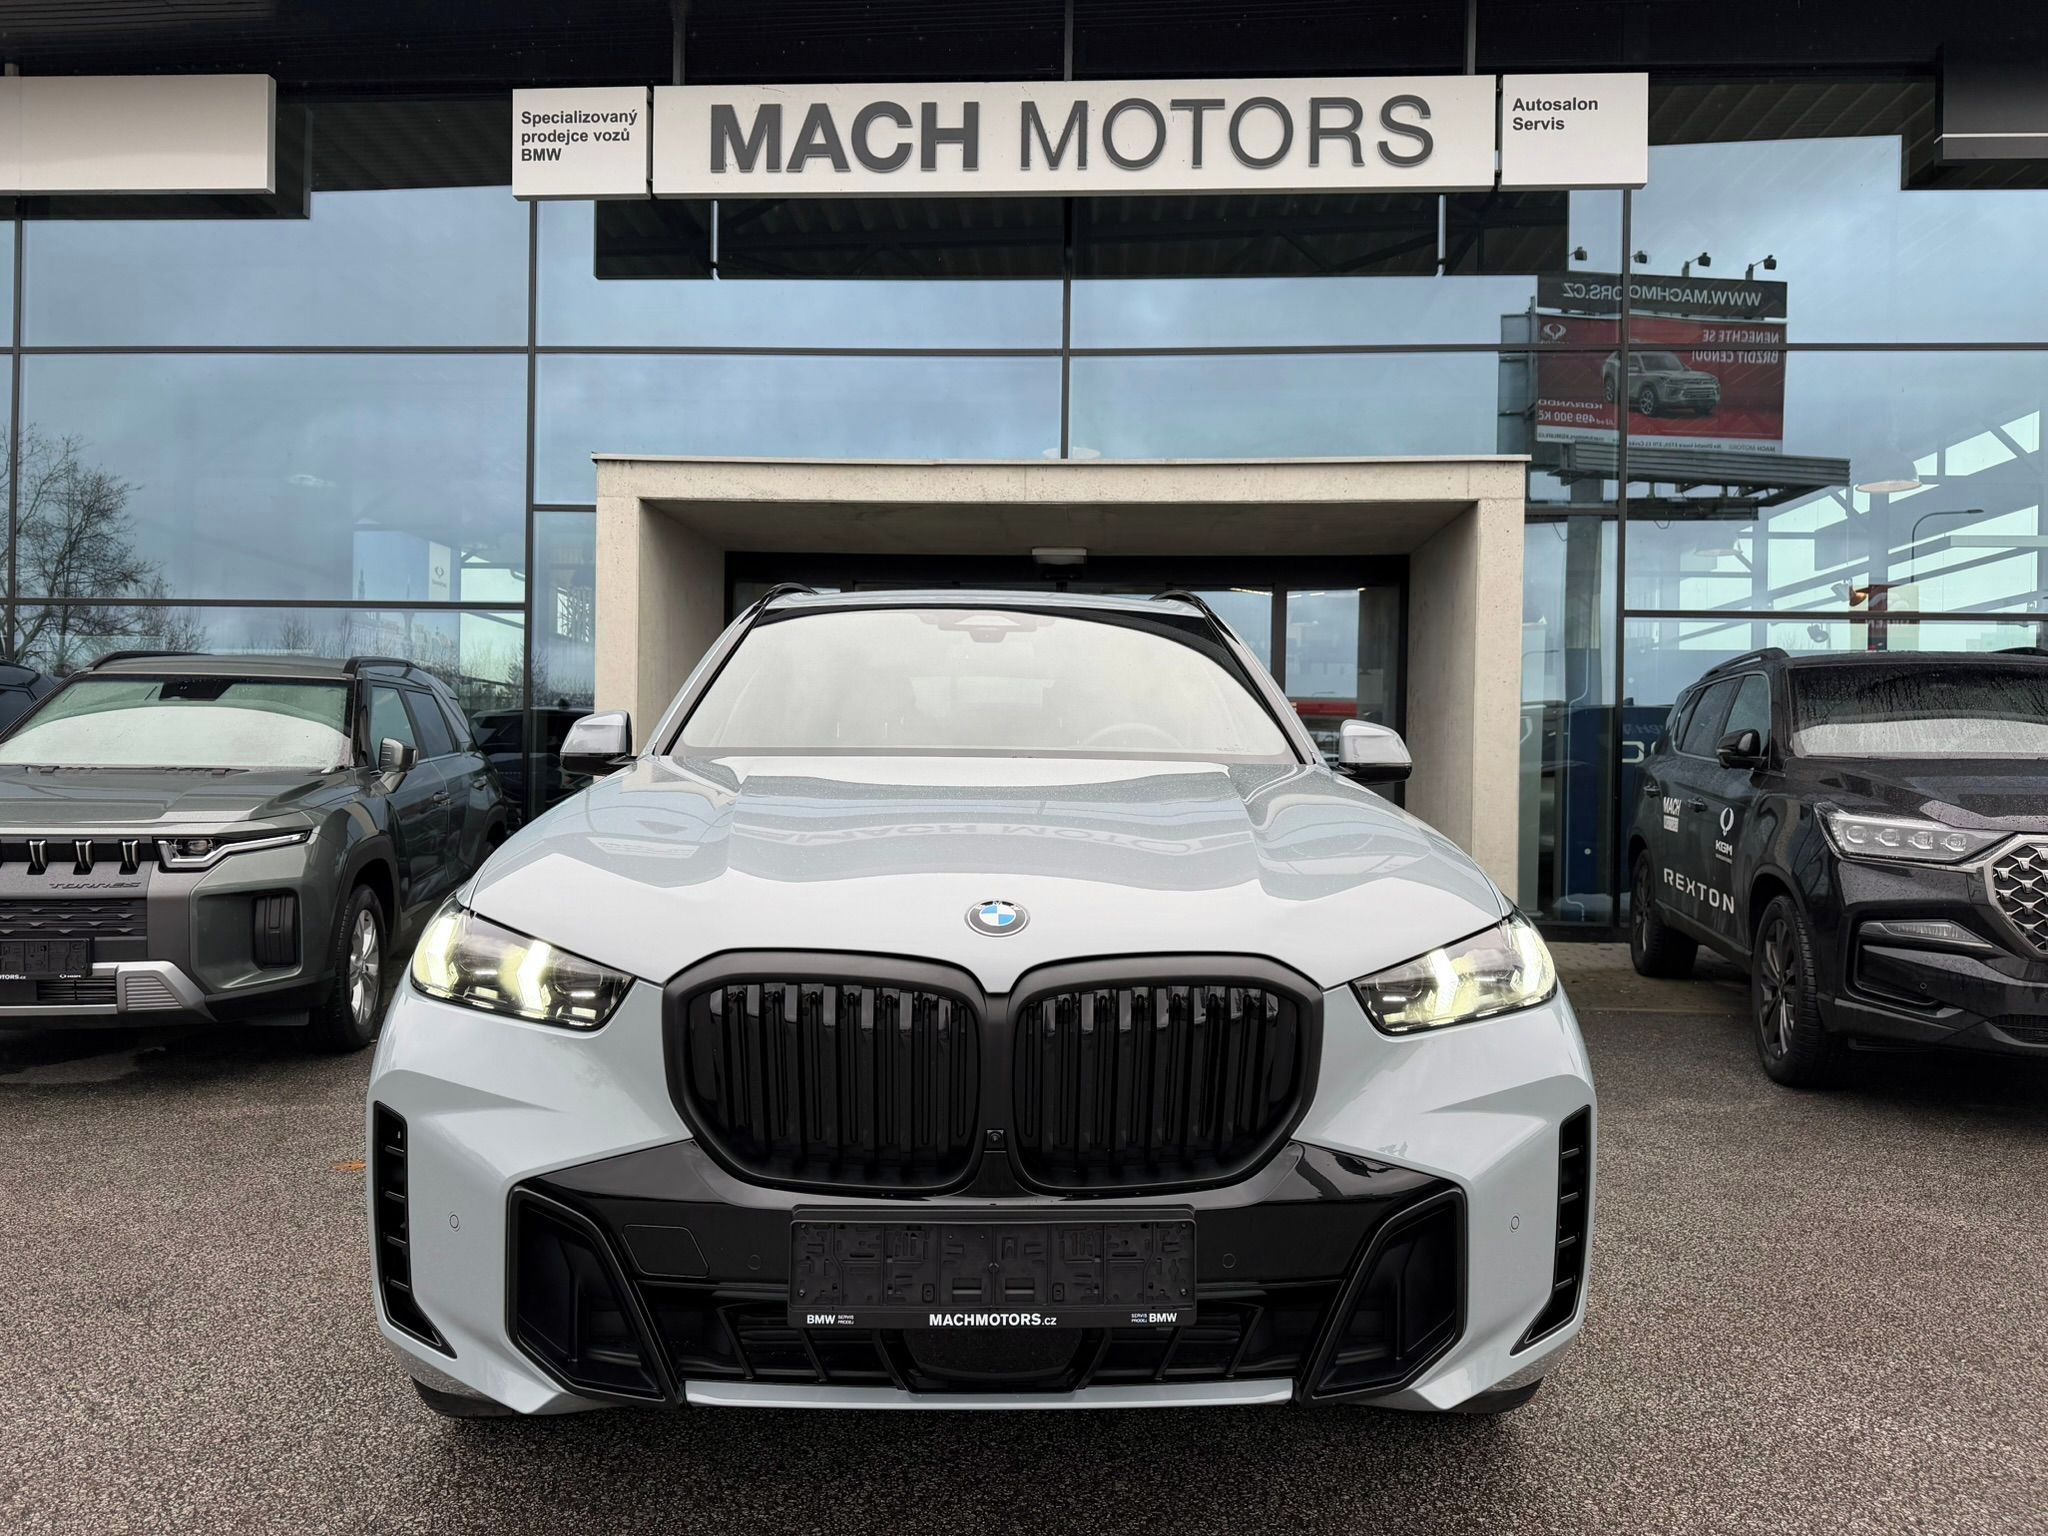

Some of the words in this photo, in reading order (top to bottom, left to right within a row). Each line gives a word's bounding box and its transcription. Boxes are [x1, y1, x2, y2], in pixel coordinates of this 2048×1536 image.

[1512, 97, 1599, 111] Autosalon
[521, 109, 638, 127] Specializovaný
[1512, 116, 1566, 131] Servis
[521, 129, 589, 146] prodejce
[593, 128, 630, 142] vozů
[710, 100, 980, 174] MACH
[1020, 94, 1435, 171] MOTORS
[521, 148, 562, 161] BMW
[1715, 839, 1733, 856] KGM
[1663, 867, 1735, 914] REXTON
[806, 1314, 836, 1325] BMW
[929, 1313, 1057, 1326] MACHMOTORS.cz
[1148, 1312, 1178, 1323] BMW
